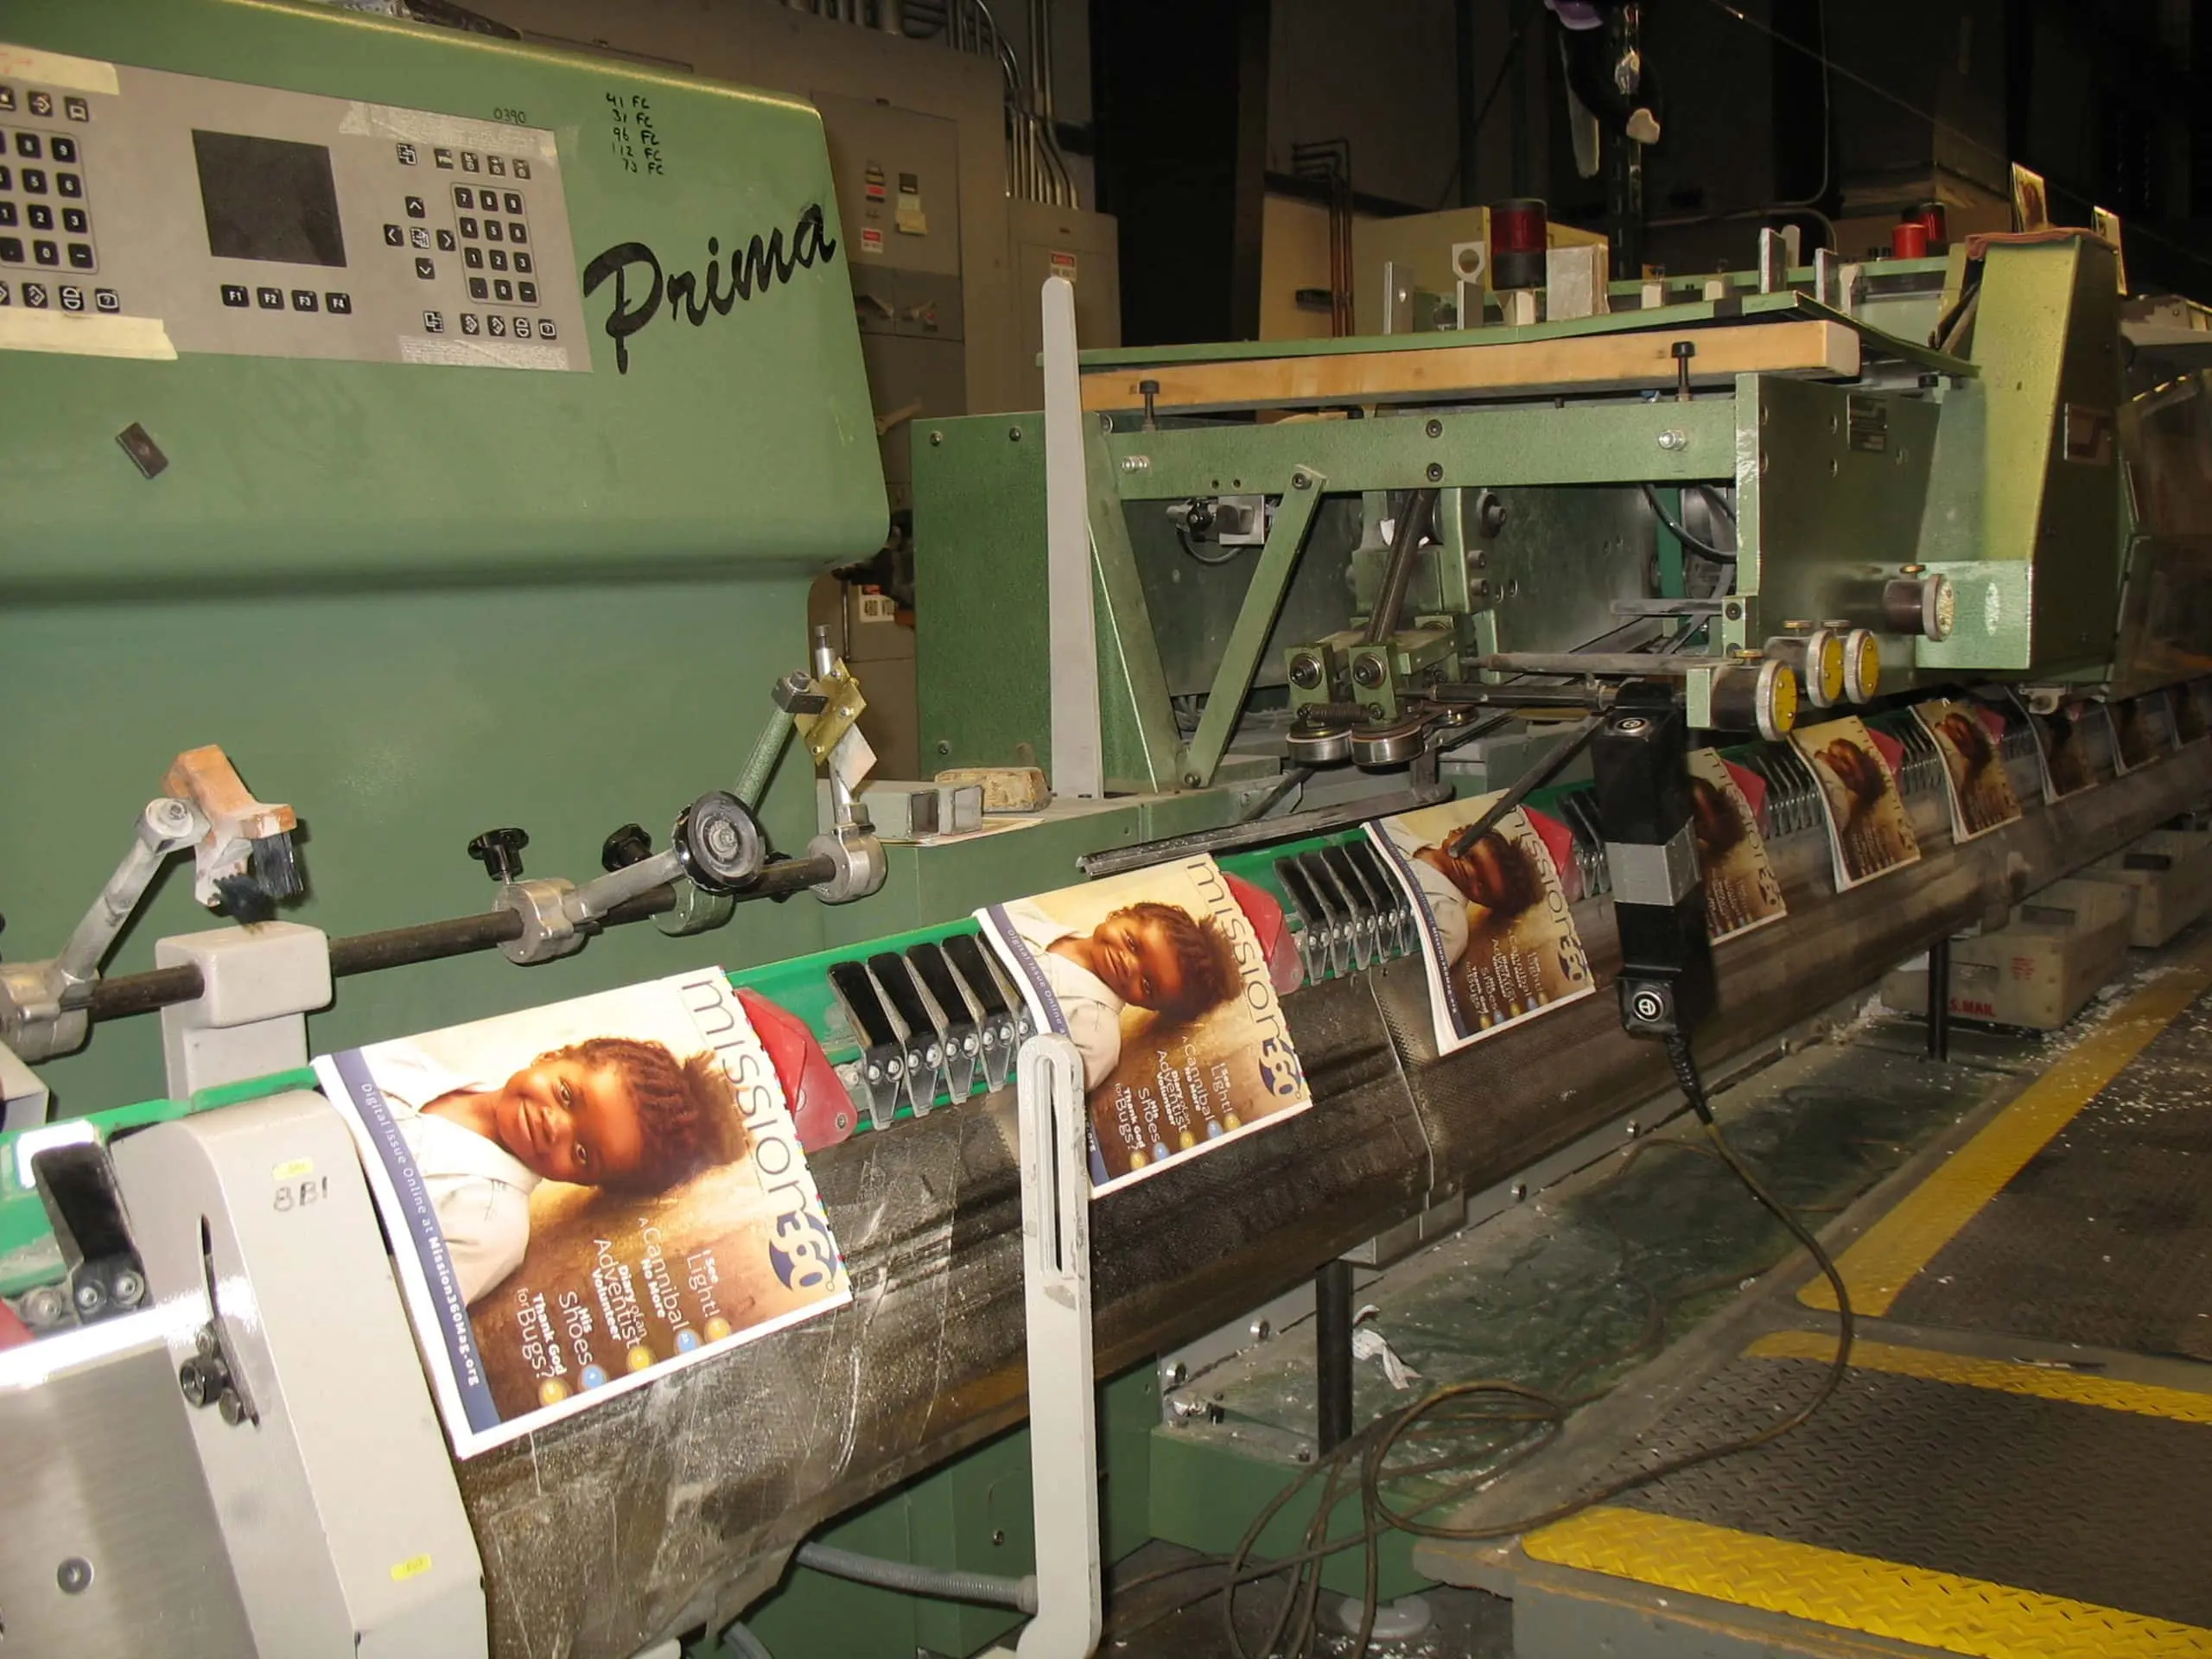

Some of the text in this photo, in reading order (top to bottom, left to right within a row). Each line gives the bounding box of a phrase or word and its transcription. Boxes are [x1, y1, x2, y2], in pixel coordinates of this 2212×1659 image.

[493, 107, 526, 124] 0390
[613, 127, 629, 142] 96
[229, 290, 243, 302] F1
[264, 293, 277, 304] F2
[299, 296, 312, 307] F3
[333, 298, 345, 308] F4
[582, 203, 836, 375] Prima
[1186, 861, 1281, 1039] mission
[1044, 989, 1063, 1026] Online
[681, 979, 807, 1211] mission
[1156, 1071, 1177, 1126] Volunteer
[1157, 1050, 1189, 1133] Adventist
[1185, 1044, 1216, 1122] Cannibal
[1124, 1086, 1147, 1148] Thank God
[1138, 1087, 1160, 1142] Shoes
[361, 1082, 391, 1128] Digital
[403, 1167, 428, 1214] Online
[422, 1217, 434, 1234] at
[428, 1236, 480, 1387] Mission360Mag.org
[593, 1238, 642, 1350] Adventist
[617, 1263, 638, 1304] Diary
[638, 1216, 690, 1332] A Cannibal
[640, 1257, 665, 1319] No More
[687, 1251, 721, 1319] Light!
[705, 1257, 719, 1284] see
[517, 1287, 556, 1379] for Bugs?
[532, 1292, 568, 1376] Thank God
[558, 1290, 594, 1366] Shoes
[578, 1306, 594, 1334] His
[592, 1267, 622, 1342] Volunteer
